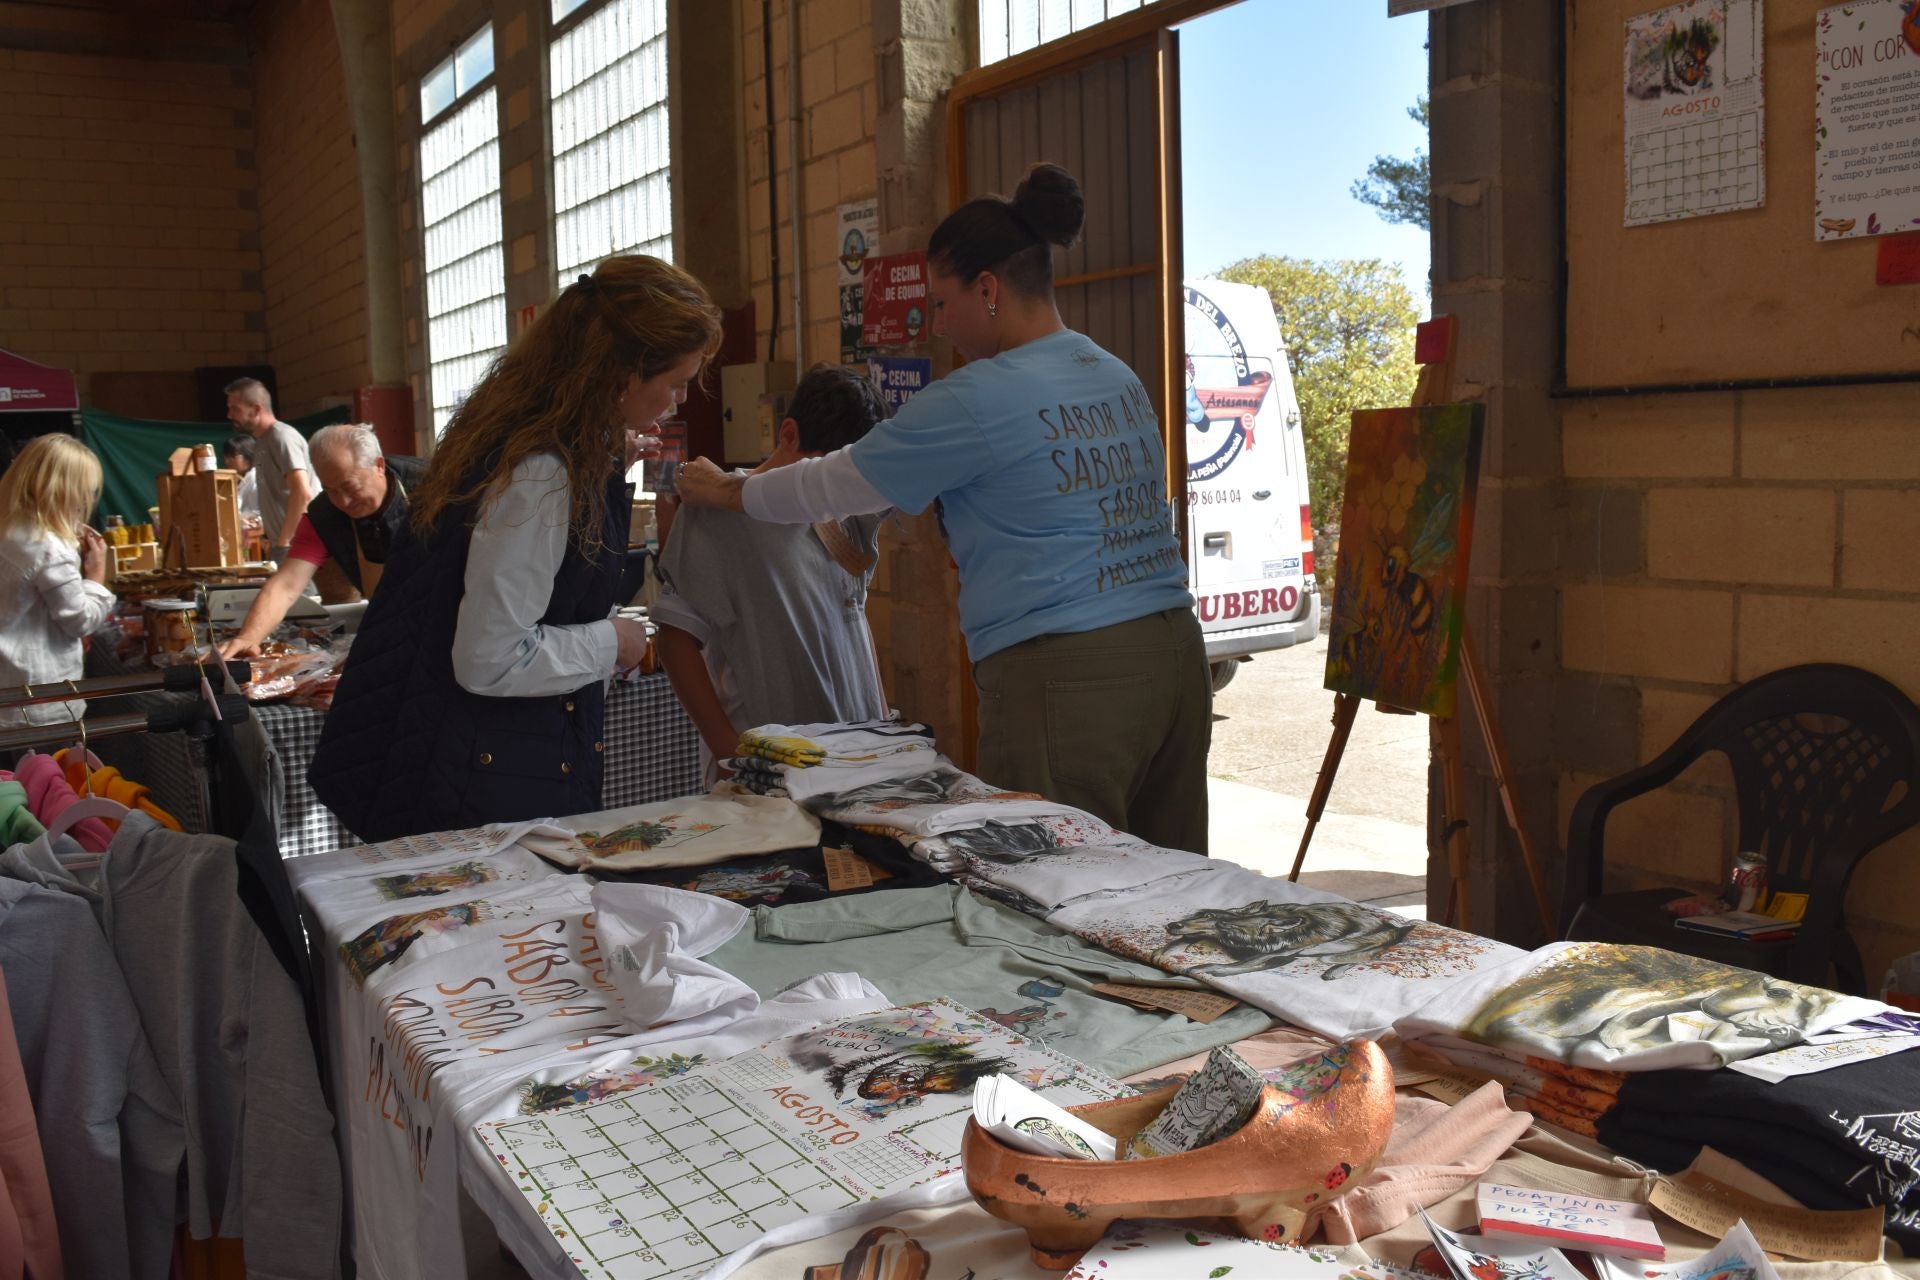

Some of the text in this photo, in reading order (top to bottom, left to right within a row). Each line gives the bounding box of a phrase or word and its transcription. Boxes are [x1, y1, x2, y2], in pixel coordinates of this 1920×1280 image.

[1841, 82, 1850, 91] El
[1852, 76, 1890, 88] corazón
[1831, 90, 1874, 104] pedacitos
[1876, 87, 1887, 95] de
[1662, 96, 1720, 118] AGOSTO
[1831, 106, 1841, 114] de
[1844, 98, 1890, 111] recuerdos
[1840, 114, 1860, 123] todo
[1862, 111, 1870, 119] lo
[1872, 110, 1890, 119] que
[1892, 106, 1908, 114] nos
[1848, 122, 1876, 132] fuerte
[1878, 121, 1884, 129] y
[1887, 118, 1903, 128] que
[1828, 150, 1838, 158] El
[1860, 146, 1868, 156] y
[1870, 144, 1879, 152] el
[1881, 141, 1894, 150] de
[1896, 139, 1909, 148] mi
[1844, 156, 1877, 169] pueblo
[1878, 156, 1886, 164] y
[1832, 170, 1864, 181] campo
[1865, 169, 1872, 178] y
[1875, 163, 1910, 174] tierras
[1829, 194, 1836, 203] Y
[1838, 193, 1846, 202] el
[1894, 185, 1910, 196] qué
[890, 265, 921, 283] CECINA
[886, 284, 926, 301] DE EQUINO
[1198, 294, 1248, 378] DEL BREZO
[889, 370, 920, 386] CECINA
[886, 390, 898, 402] DE
[1038, 402, 1119, 440] SABOR
[1120, 394, 1138, 431] A
[1051, 442, 1136, 493] SABOR
[1138, 435, 1155, 472] A
[1198, 464, 1218, 480] PEÑA
[1202, 491, 1212, 504] 86
[1216, 490, 1226, 504] 04
[1230, 489, 1241, 502] 04
[1098, 480, 1161, 528] SABOR
[499, 919, 590, 1006] SABOR
[436, 976, 530, 1041] SABOR
[826, 1029, 869, 1040] SALVA
[856, 1025, 908, 1038] PUEBLO
[818, 1038, 882, 1052] PUEBLO
[610, 1100, 624, 1110] 10
[668, 1106, 678, 1114] 4
[763, 1086, 860, 1145] AGOSTO
[528, 1120, 542, 1132] 24
[627, 1118, 642, 1128] 11
[686, 1120, 701, 1128] 5
[586, 1129, 602, 1140] 18
[646, 1134, 662, 1146] 12
[800, 1130, 831, 1151] 2026
[510, 1138, 524, 1149] 31
[542, 1139, 558, 1151] 25
[708, 1138, 719, 1146] 6
[602, 1148, 618, 1158] 19
[666, 1153, 683, 1165] 13
[560, 1159, 573, 1172] 26
[622, 1167, 638, 1180] 20
[686, 1172, 702, 1184] 14
[576, 1181, 594, 1191] 27
[752, 1177, 765, 1185] 8
[819, 1182, 832, 1190] 2
[640, 1188, 656, 1200] 21
[708, 1192, 727, 1205] 15
[1492, 1186, 1623, 1212] PEGATINAS
[595, 1200, 612, 1215] 28
[776, 1196, 789, 1207] 9
[662, 1210, 679, 1222] 22
[1496, 1204, 1610, 1227] PULSERAS
[732, 1216, 750, 1230] 16
[616, 1224, 632, 1238] 29
[684, 1230, 704, 1248] 23
[635, 1248, 654, 1262] 30
